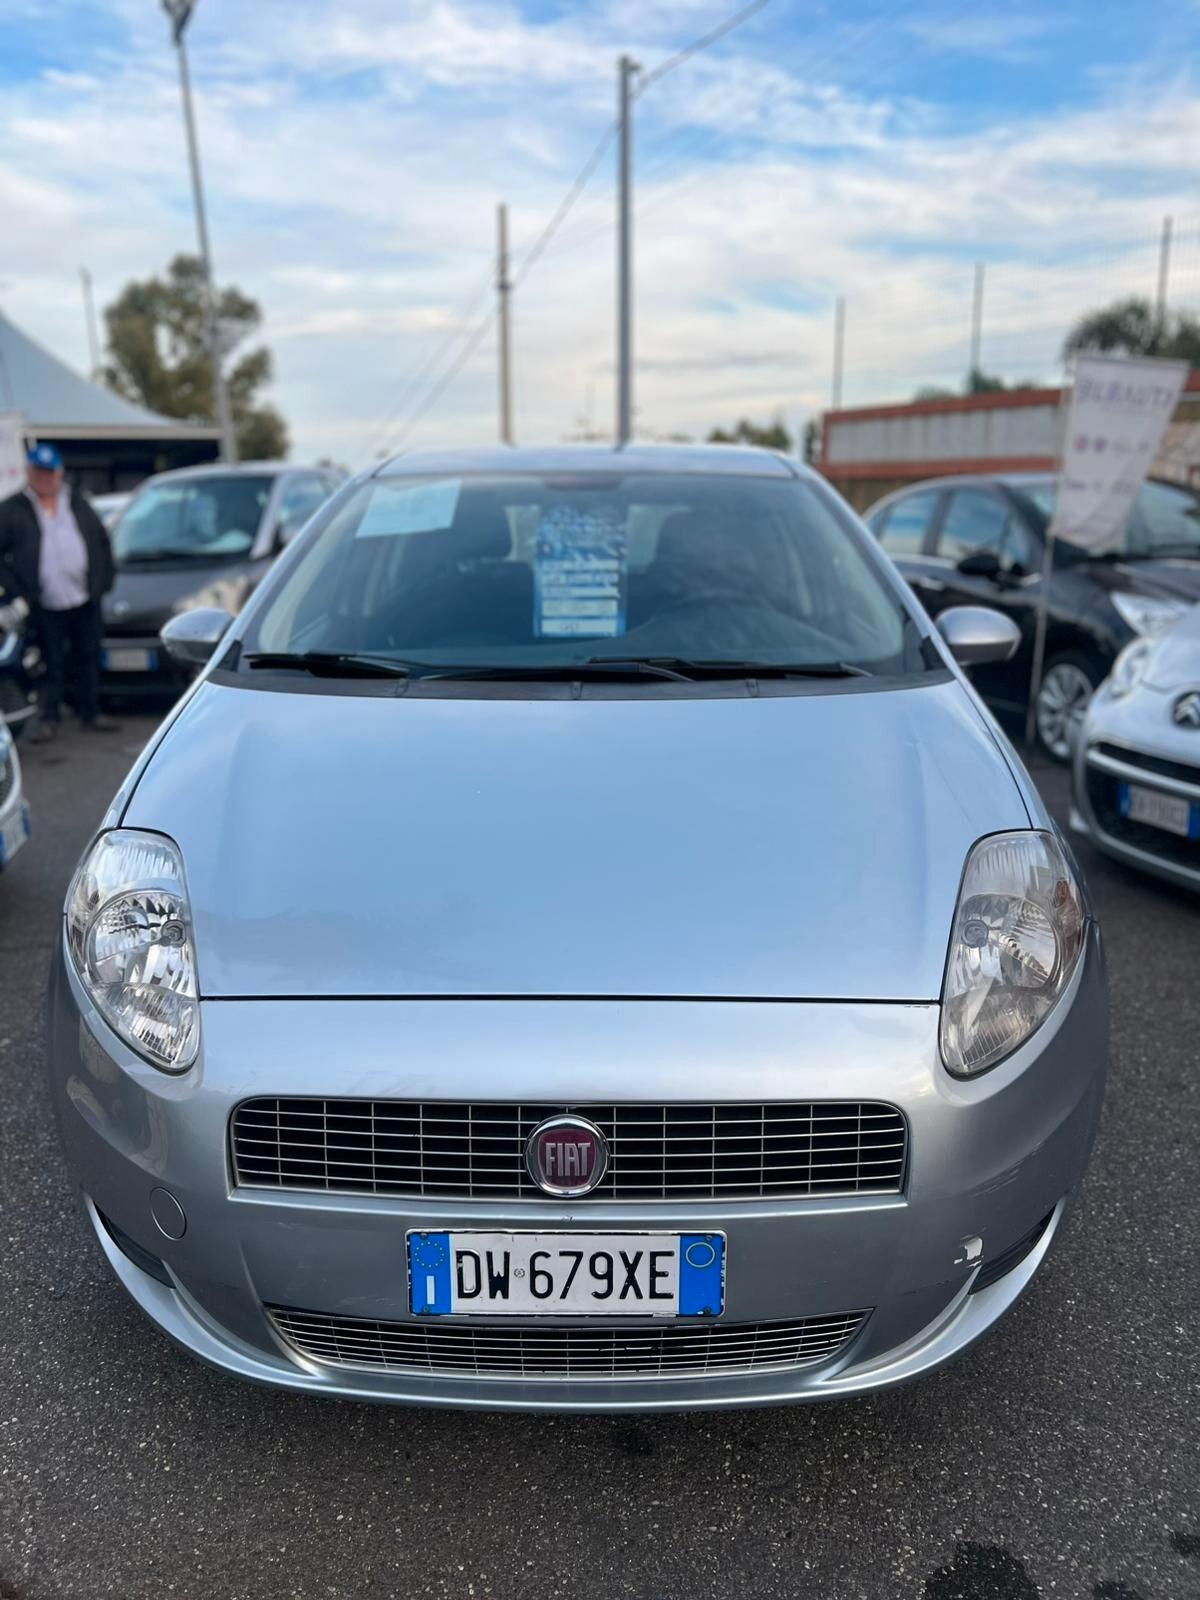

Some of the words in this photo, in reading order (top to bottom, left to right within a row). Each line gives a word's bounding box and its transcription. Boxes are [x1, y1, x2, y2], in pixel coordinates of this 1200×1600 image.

[545, 1142, 591, 1176] FIAT
[455, 1249, 510, 1299] DW
[529, 1249, 675, 1300] 679XE
